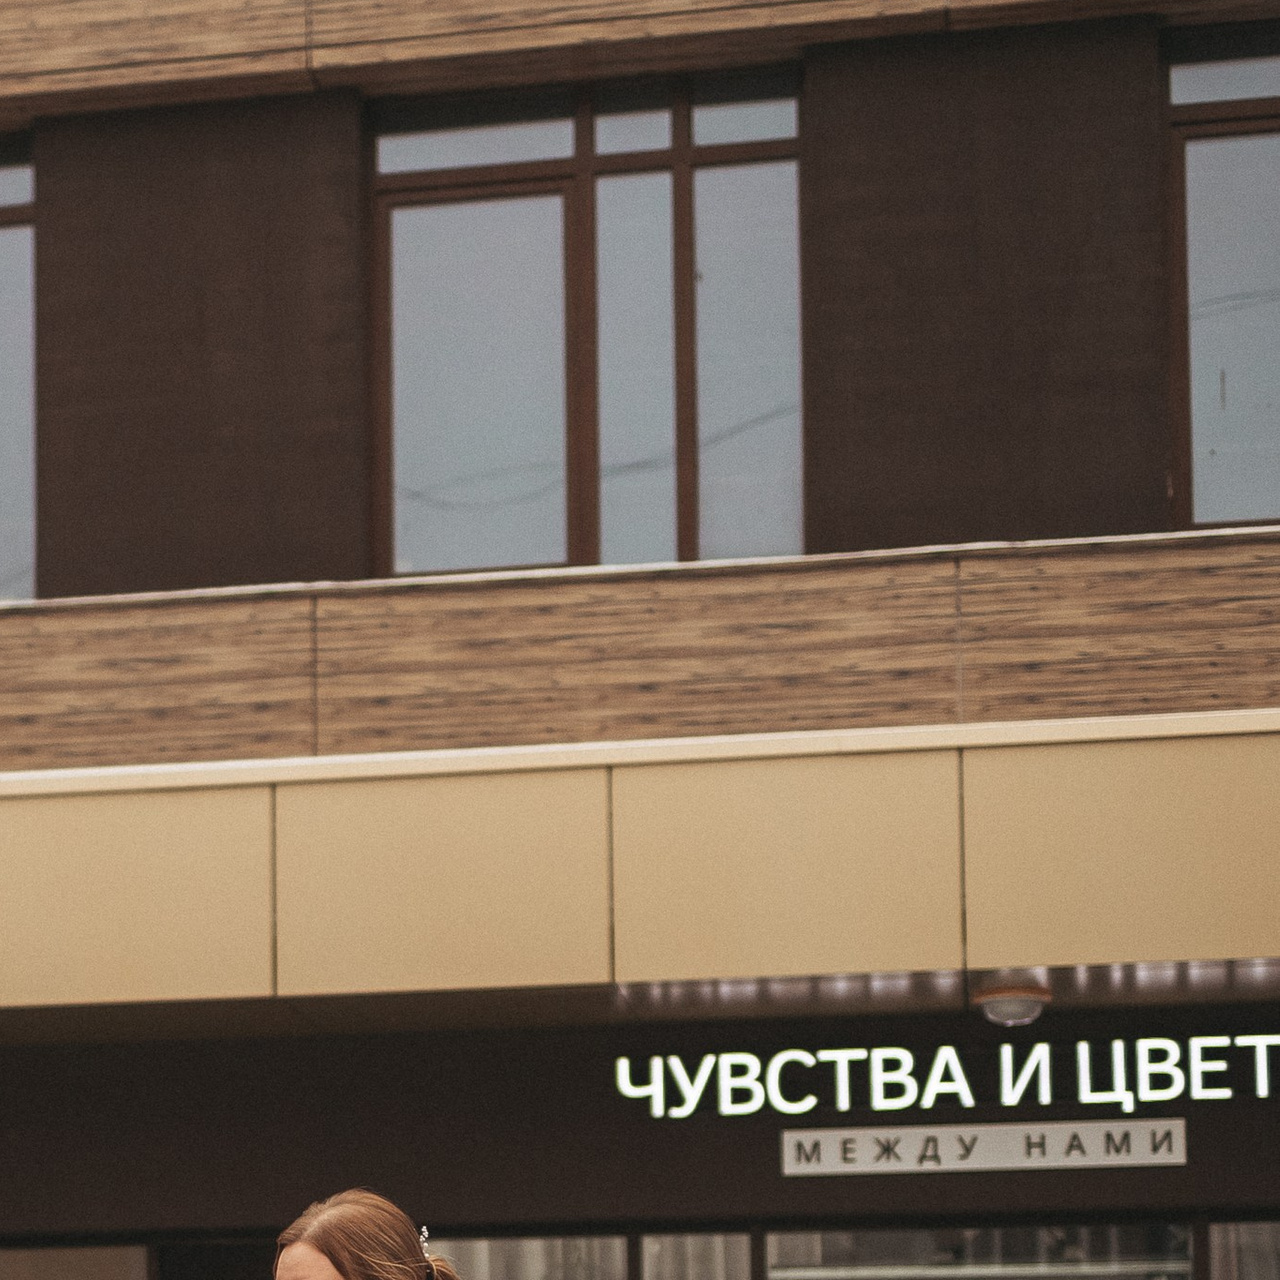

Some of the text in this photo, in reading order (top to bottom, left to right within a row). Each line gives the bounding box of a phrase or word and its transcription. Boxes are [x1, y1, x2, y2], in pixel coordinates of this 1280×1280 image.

[615, 1033, 1280, 1119] ЧУВСТВА И ЦВЕТ
[793, 1129, 1174, 1166] МЕЖДУ НАМИ
